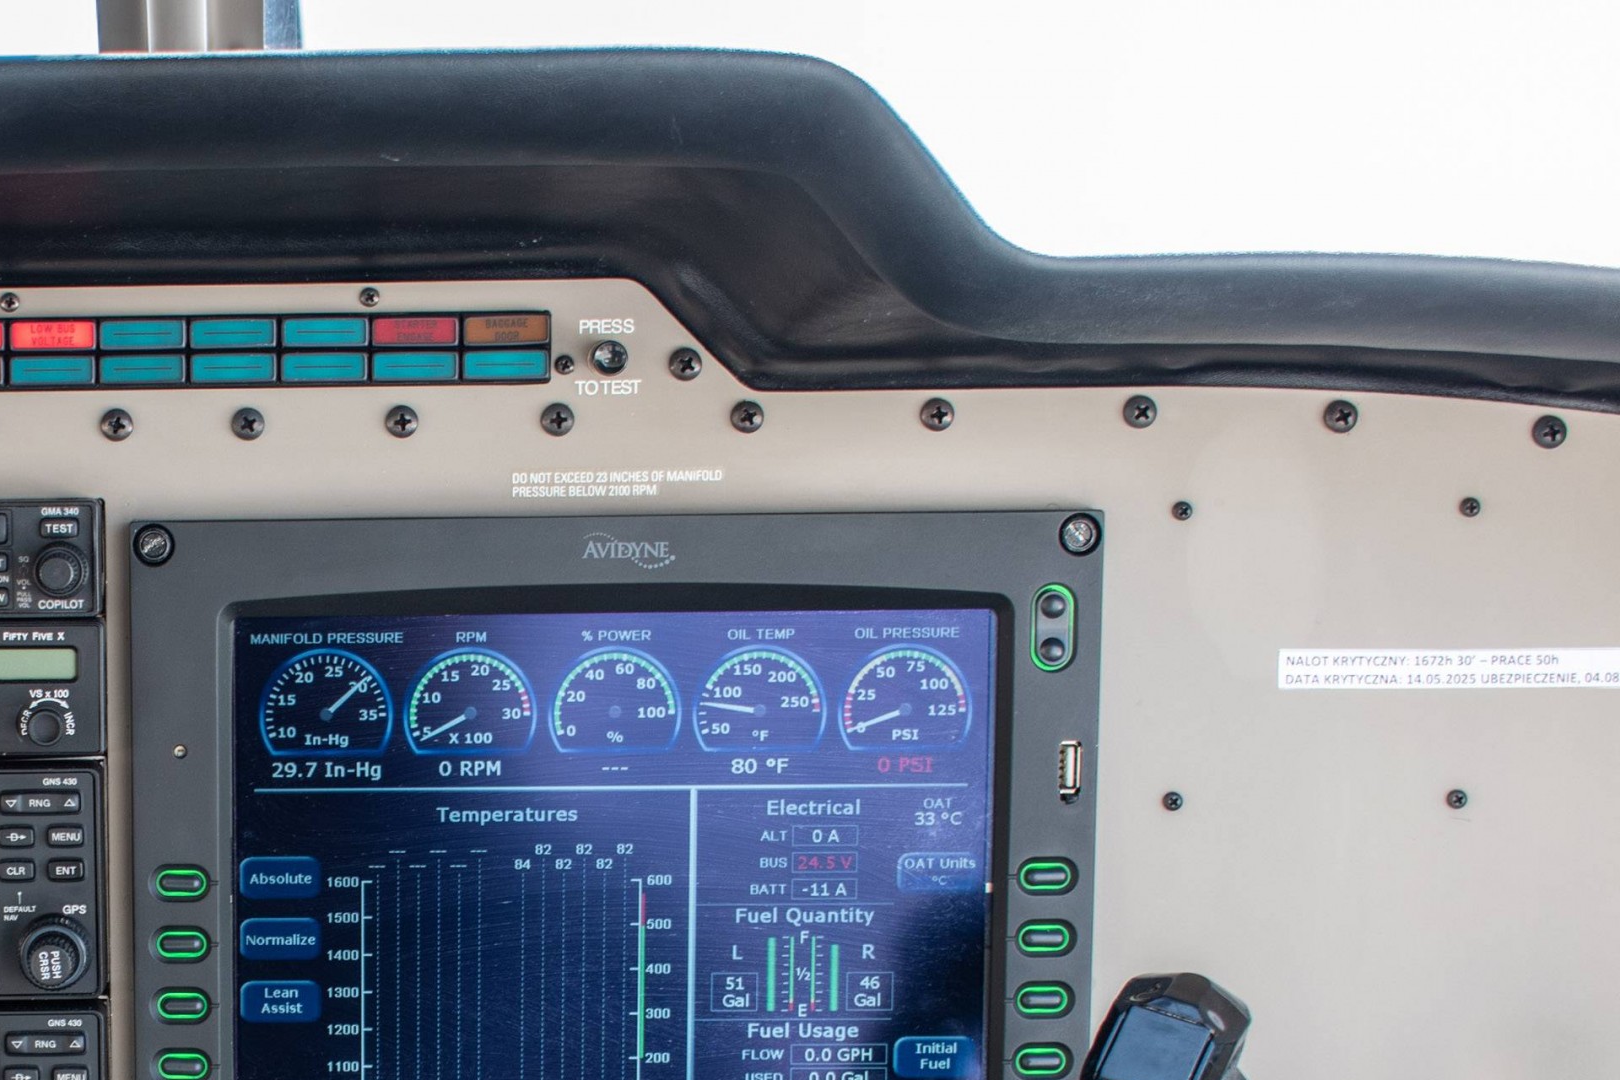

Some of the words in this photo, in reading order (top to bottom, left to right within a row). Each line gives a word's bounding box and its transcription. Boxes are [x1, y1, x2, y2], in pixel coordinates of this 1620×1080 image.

[579, 319, 634, 335] PRESS
[575, 381, 601, 396] TO
[604, 380, 641, 395] TEST
[512, 472, 523, 484] DO
[525, 472, 552, 484] NOT
[555, 471, 594, 484] EXCEED
[596, 471, 607, 483] 23
[609, 471, 648, 483] INCHES
[651, 470, 664, 482] OF
[666, 470, 722, 482] MANIFOLD
[512, 486, 566, 497] PRESSURE
[568, 485, 606, 496] BELOW
[608, 485, 630, 496] 2100
[632, 485, 657, 496] RPM
[45, 524, 73, 533] TEST
[582, 541, 669, 559] AVIDYNE
[38, 600, 84, 609] COPILOT
[250, 633, 322, 645] MANIFOLD
[328, 632, 403, 644] PRESSURE
[456, 632, 487, 643] RPM
[728, 629, 751, 639] OIL
[756, 628, 794, 639] TEMP
[854, 628, 878, 638] OIL
[883, 627, 960, 638] PRESSURE
[1286, 656, 1329, 666] NALOT
[1333, 656, 1410, 667] KRYTYCZNY:
[1414, 656, 1453, 666] 1672h
[1491, 655, 1532, 665] PRACE
[1536, 654, 1559, 665] 50h
[1285, 674, 1319, 684] DATA
[1324, 674, 1403, 684] KRYTYCZNA:
[1407, 673, 1476, 684] 14.05.2025
[1481, 673, 1581, 684] UBEZPIECZENIE,
[272, 762, 317, 778] 29.7
[324, 762, 382, 780] In-Hg
[439, 761, 451, 777] 0
[460, 761, 501, 776] RPM
[731, 759, 757, 774] 80
[767, 800, 860, 816] Electrical
[436, 808, 578, 824] Temperatures
[52, 833, 80, 841] MENU
[7, 867, 25, 875] CLR
[56, 866, 76, 875] ENT
[249, 872, 312, 885] Absolute
[63, 905, 87, 914] GPS
[736, 908, 777, 923] Fuel
[786, 908, 875, 926] Quantity
[245, 934, 316, 946] Normalize
[264, 988, 299, 998] Lean
[261, 1002, 303, 1014] Assist
[748, 1024, 789, 1038] Fuel
[799, 1024, 859, 1040] Usage
[915, 1043, 957, 1054] Initial
[742, 1050, 784, 1060] FLOW
[805, 1049, 831, 1062] 0.0
[837, 1049, 872, 1062] GPH
[920, 1059, 951, 1069] Fuel
